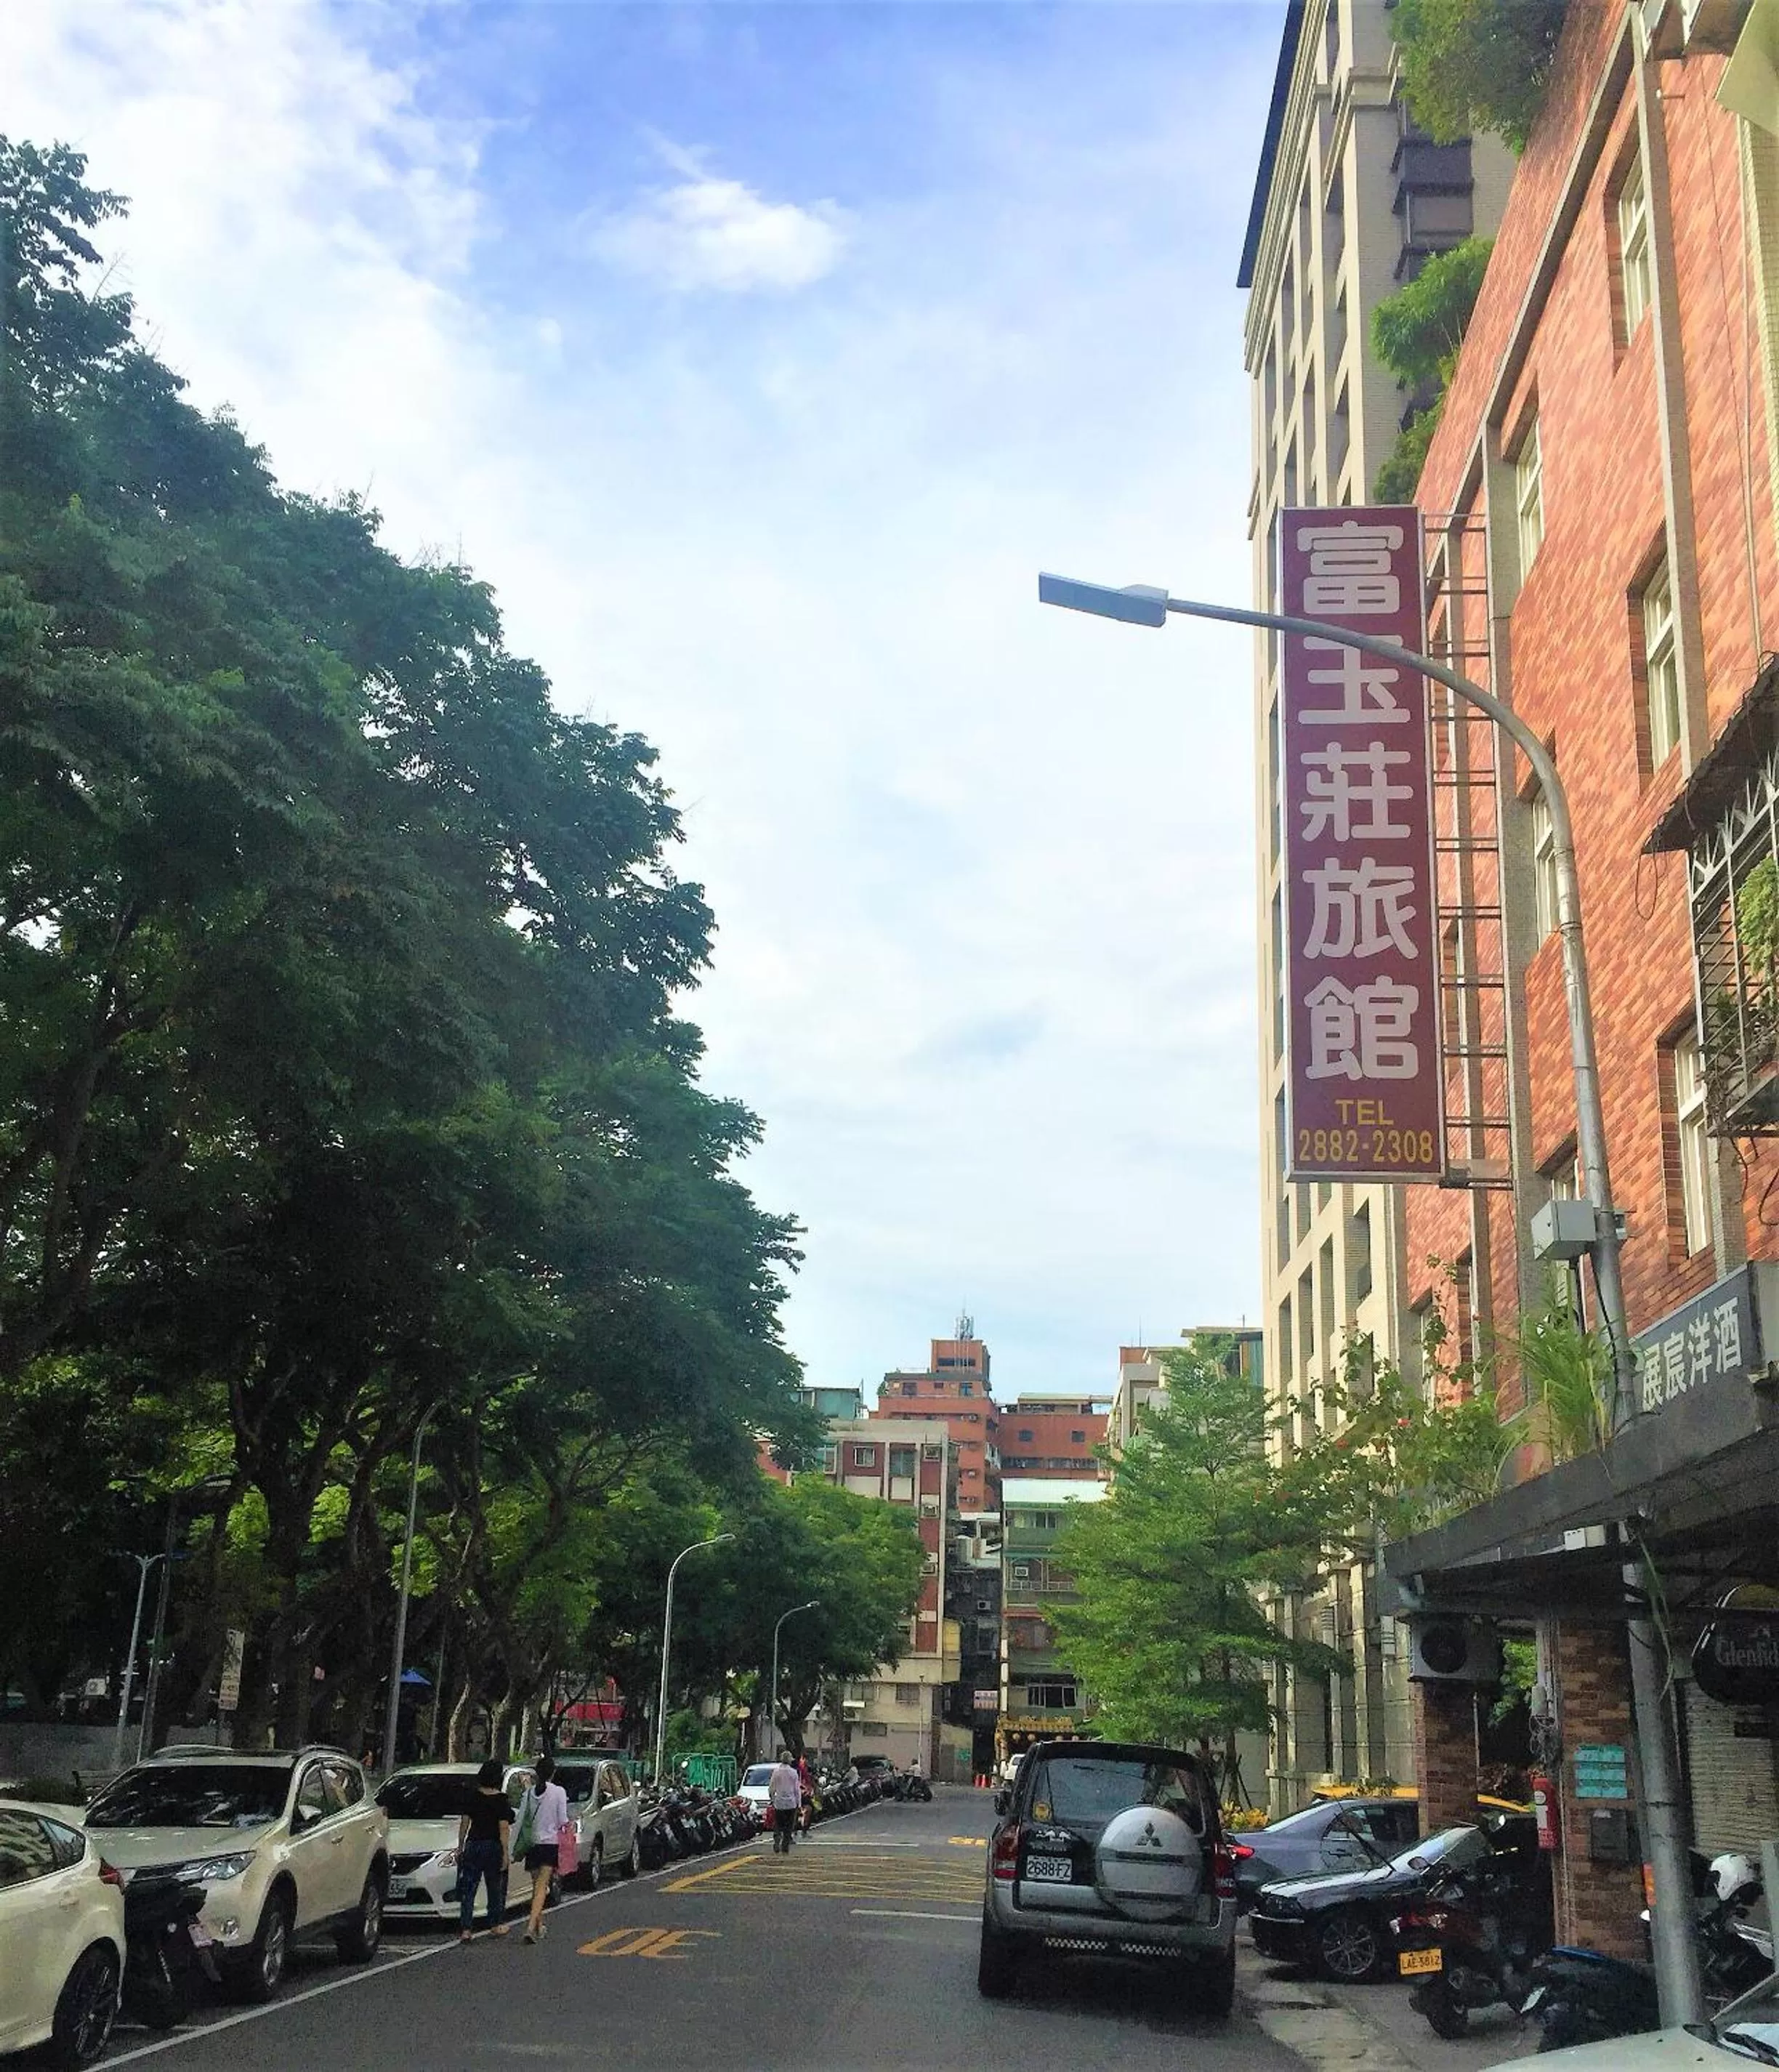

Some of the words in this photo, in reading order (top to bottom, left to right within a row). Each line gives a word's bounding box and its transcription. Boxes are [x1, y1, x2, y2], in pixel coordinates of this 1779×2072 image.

[1297, 520, 1419, 1081] 富玉莊旅館
[1335, 1099, 1394, 1126] TEL
[1299, 1129, 1434, 1164] 2882-2308
